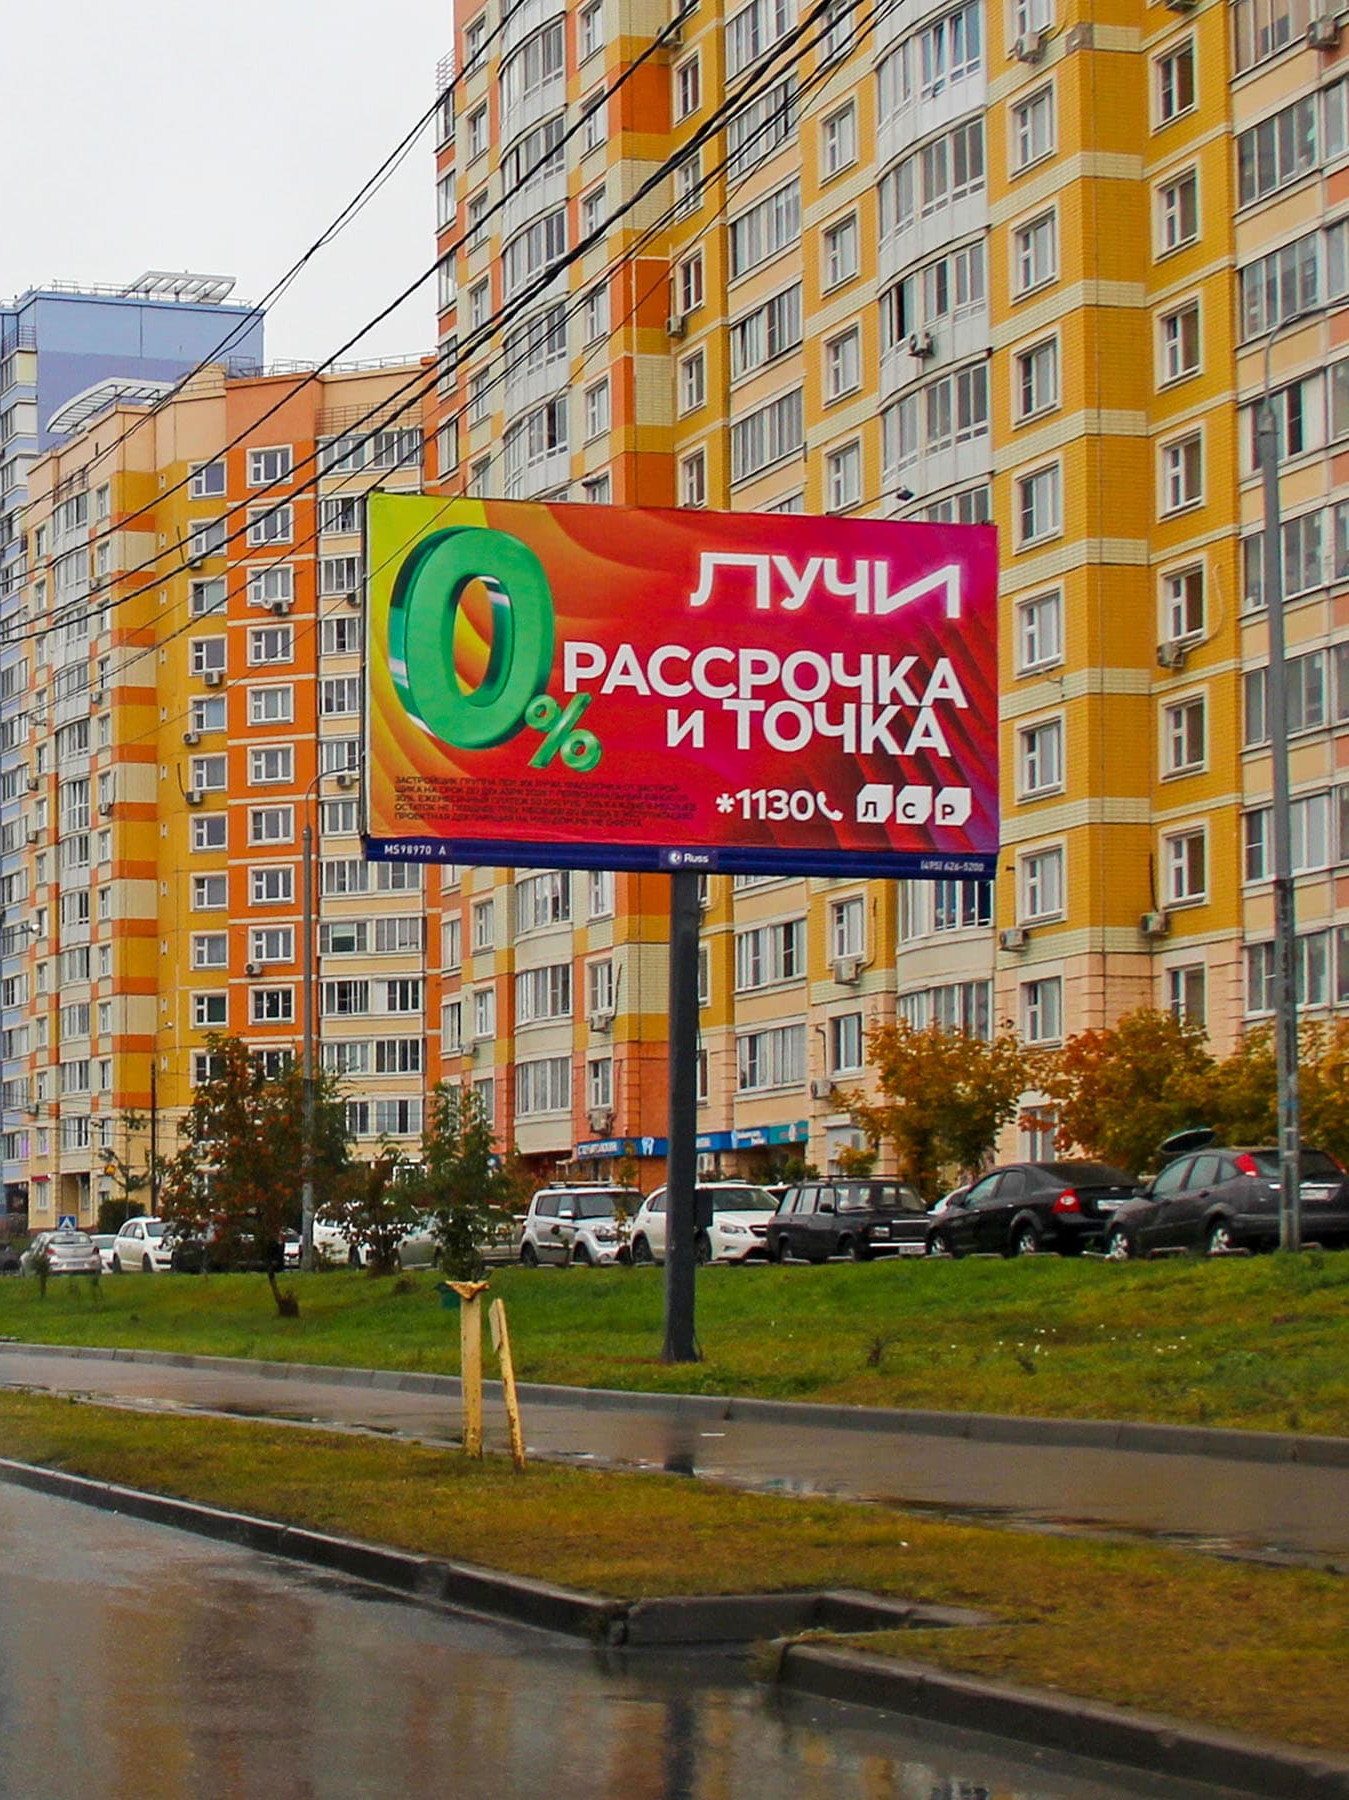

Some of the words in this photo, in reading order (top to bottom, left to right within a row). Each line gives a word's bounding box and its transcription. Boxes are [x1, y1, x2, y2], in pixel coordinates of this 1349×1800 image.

[690, 552, 961, 619] ЛУЧИ
[563, 640, 969, 709] РАССРОЧКА
[722, 698, 952, 758] ТОЧКА
[683, 852, 710, 863] Russ
